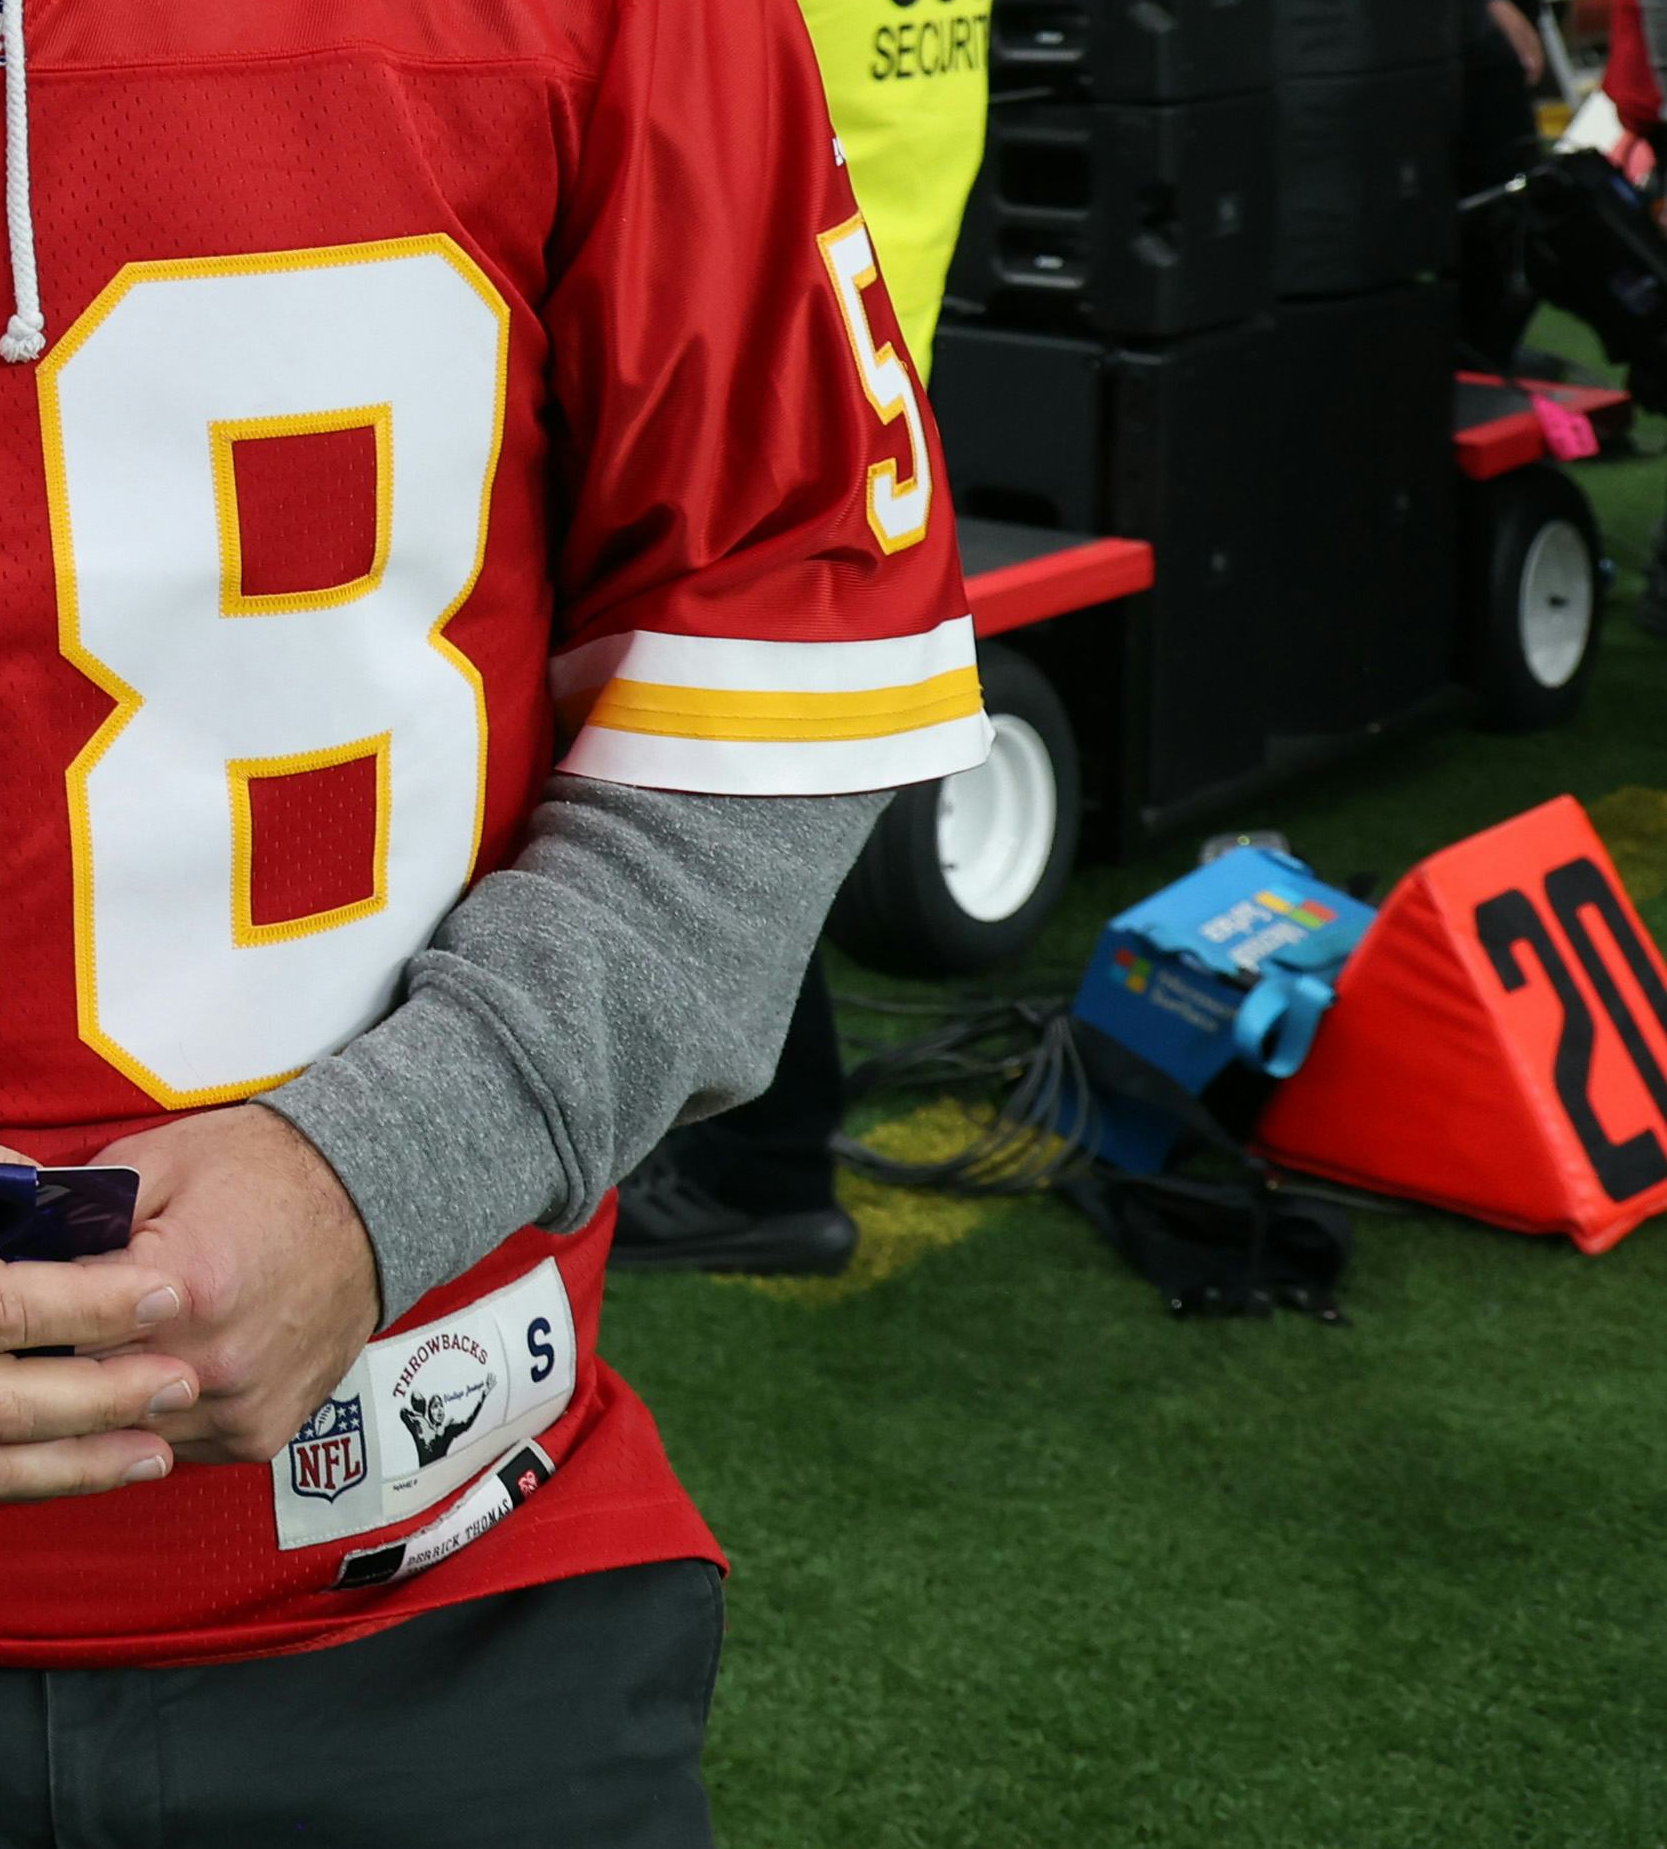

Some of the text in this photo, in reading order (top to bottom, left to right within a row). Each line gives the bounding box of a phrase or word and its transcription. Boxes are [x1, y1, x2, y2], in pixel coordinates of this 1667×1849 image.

[871, 14, 988, 82] SECURIT
[817, 208, 937, 556] 5
[1474, 856, 1667, 1202] 20
[392, 1333, 488, 1399] THROWBACKS
[527, 1317, 555, 1383] S
[297, 1437, 361, 1492] NFL
[393, 1481, 412, 1492] NAME
[407, 1534, 461, 1567] DERRICK
[465, 1498, 510, 1539] THOMAS
